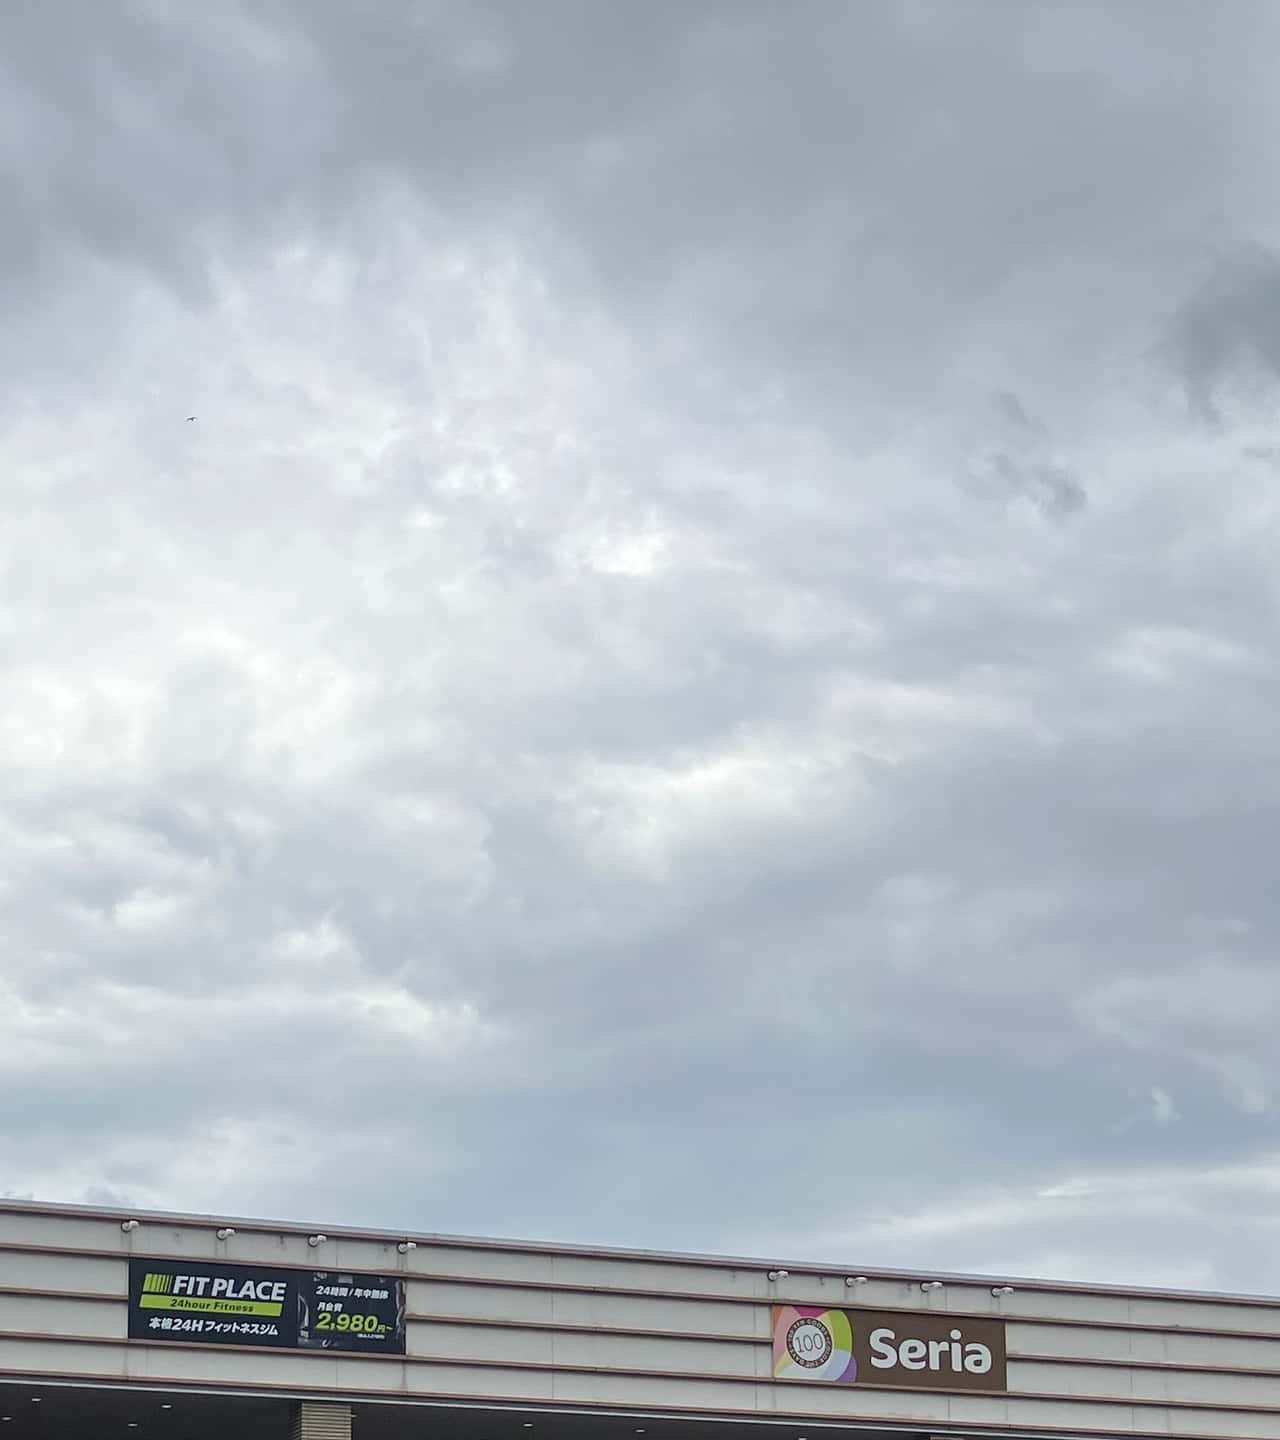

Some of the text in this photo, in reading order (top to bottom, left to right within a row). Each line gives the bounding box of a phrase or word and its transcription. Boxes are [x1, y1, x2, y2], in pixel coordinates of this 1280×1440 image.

[172, 1275, 287, 1301] FIT PLACE
[170, 1298, 254, 1313] 24hour Fitness
[795, 1332, 825, 1354] 100
[869, 1328, 992, 1374] Seria
